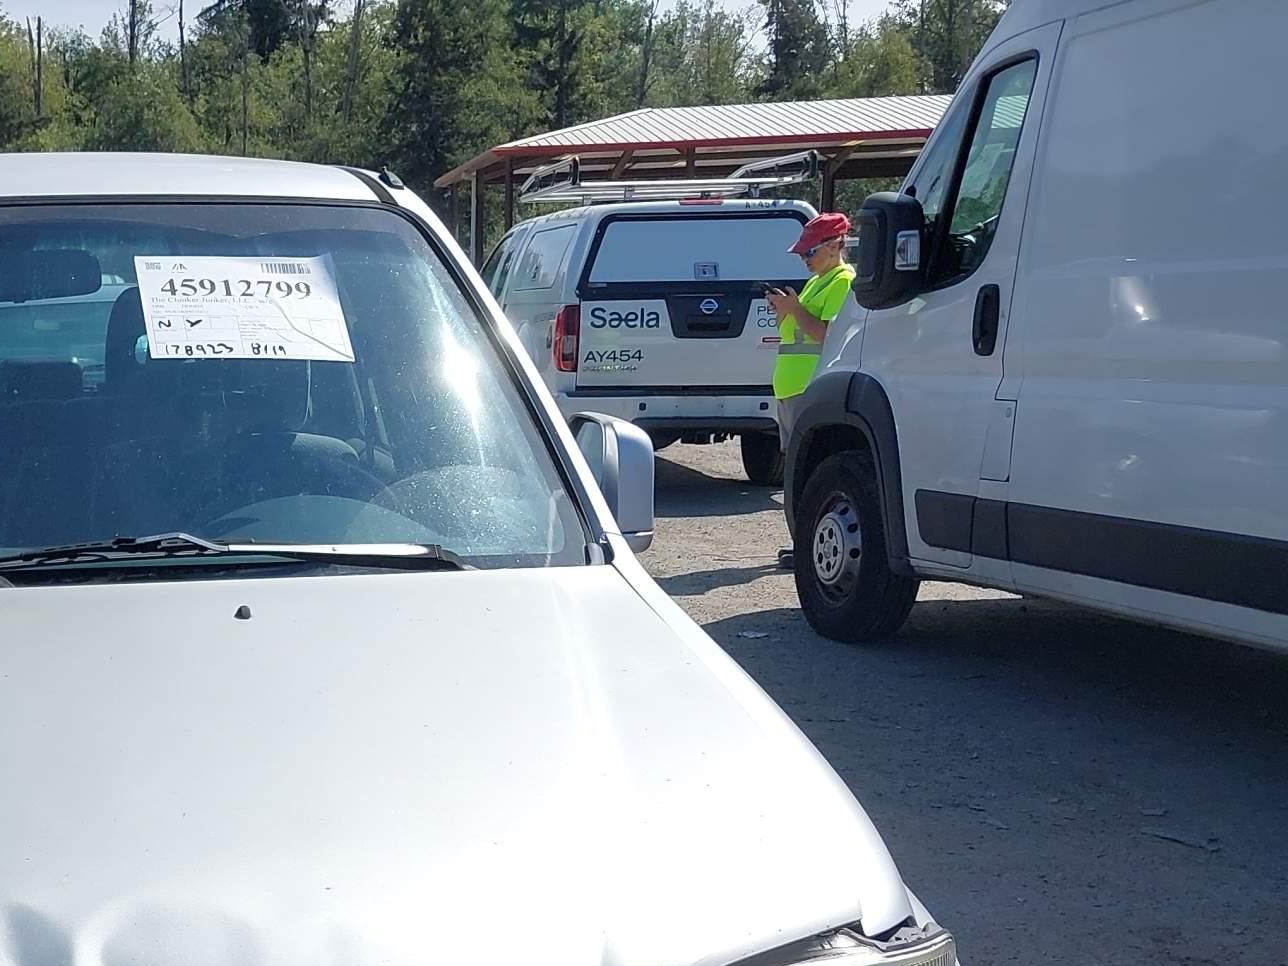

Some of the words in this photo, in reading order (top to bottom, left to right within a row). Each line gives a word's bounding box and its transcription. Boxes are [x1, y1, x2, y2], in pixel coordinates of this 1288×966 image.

[161, 278, 312, 300] 45912799
[590, 307, 660, 329] Saela
[584, 349, 644, 363] AY454
